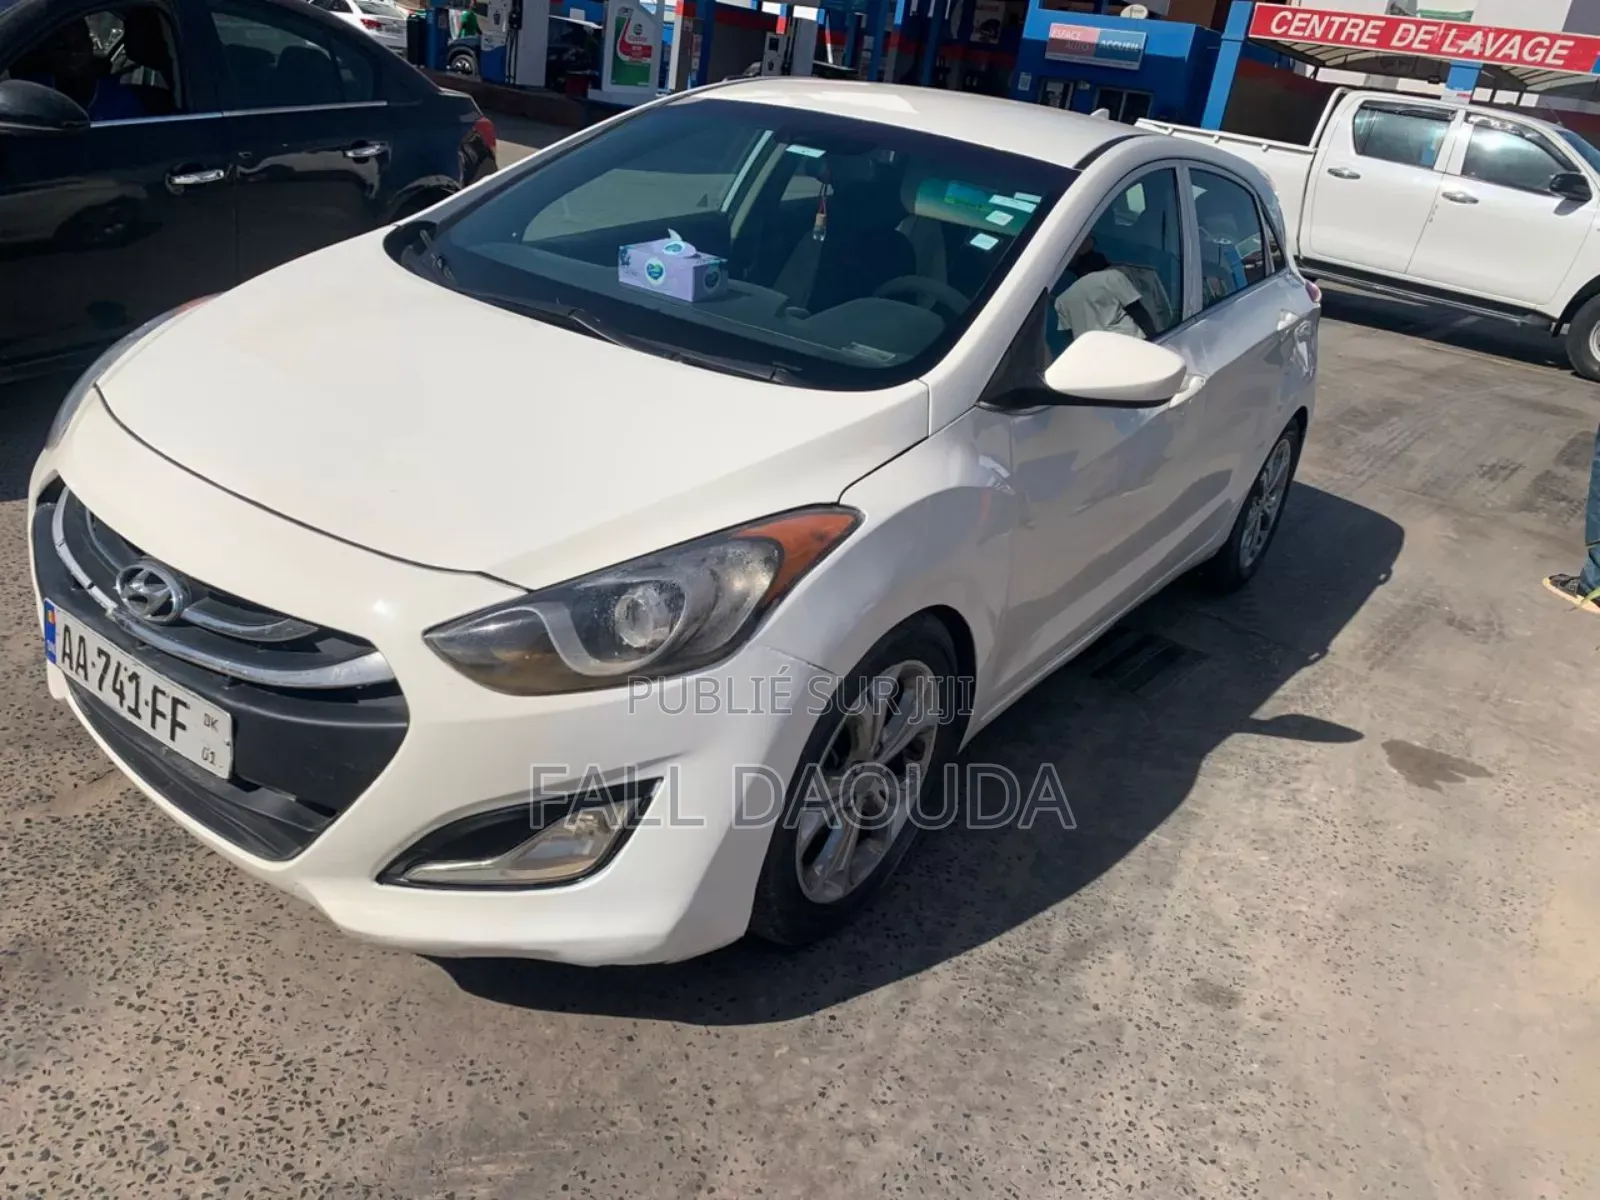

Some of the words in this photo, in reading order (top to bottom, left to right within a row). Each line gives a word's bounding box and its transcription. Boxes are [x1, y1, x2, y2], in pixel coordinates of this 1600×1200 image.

[1099, 40, 1139, 52] ACCUEIL
[1270, 11, 1387, 45] CENTRE
[1390, 24, 1438, 51] DE
[1441, 27, 1576, 66] LAVAGE
[61, 623, 191, 743] AA-741-FF
[203, 712, 219, 733] DK
